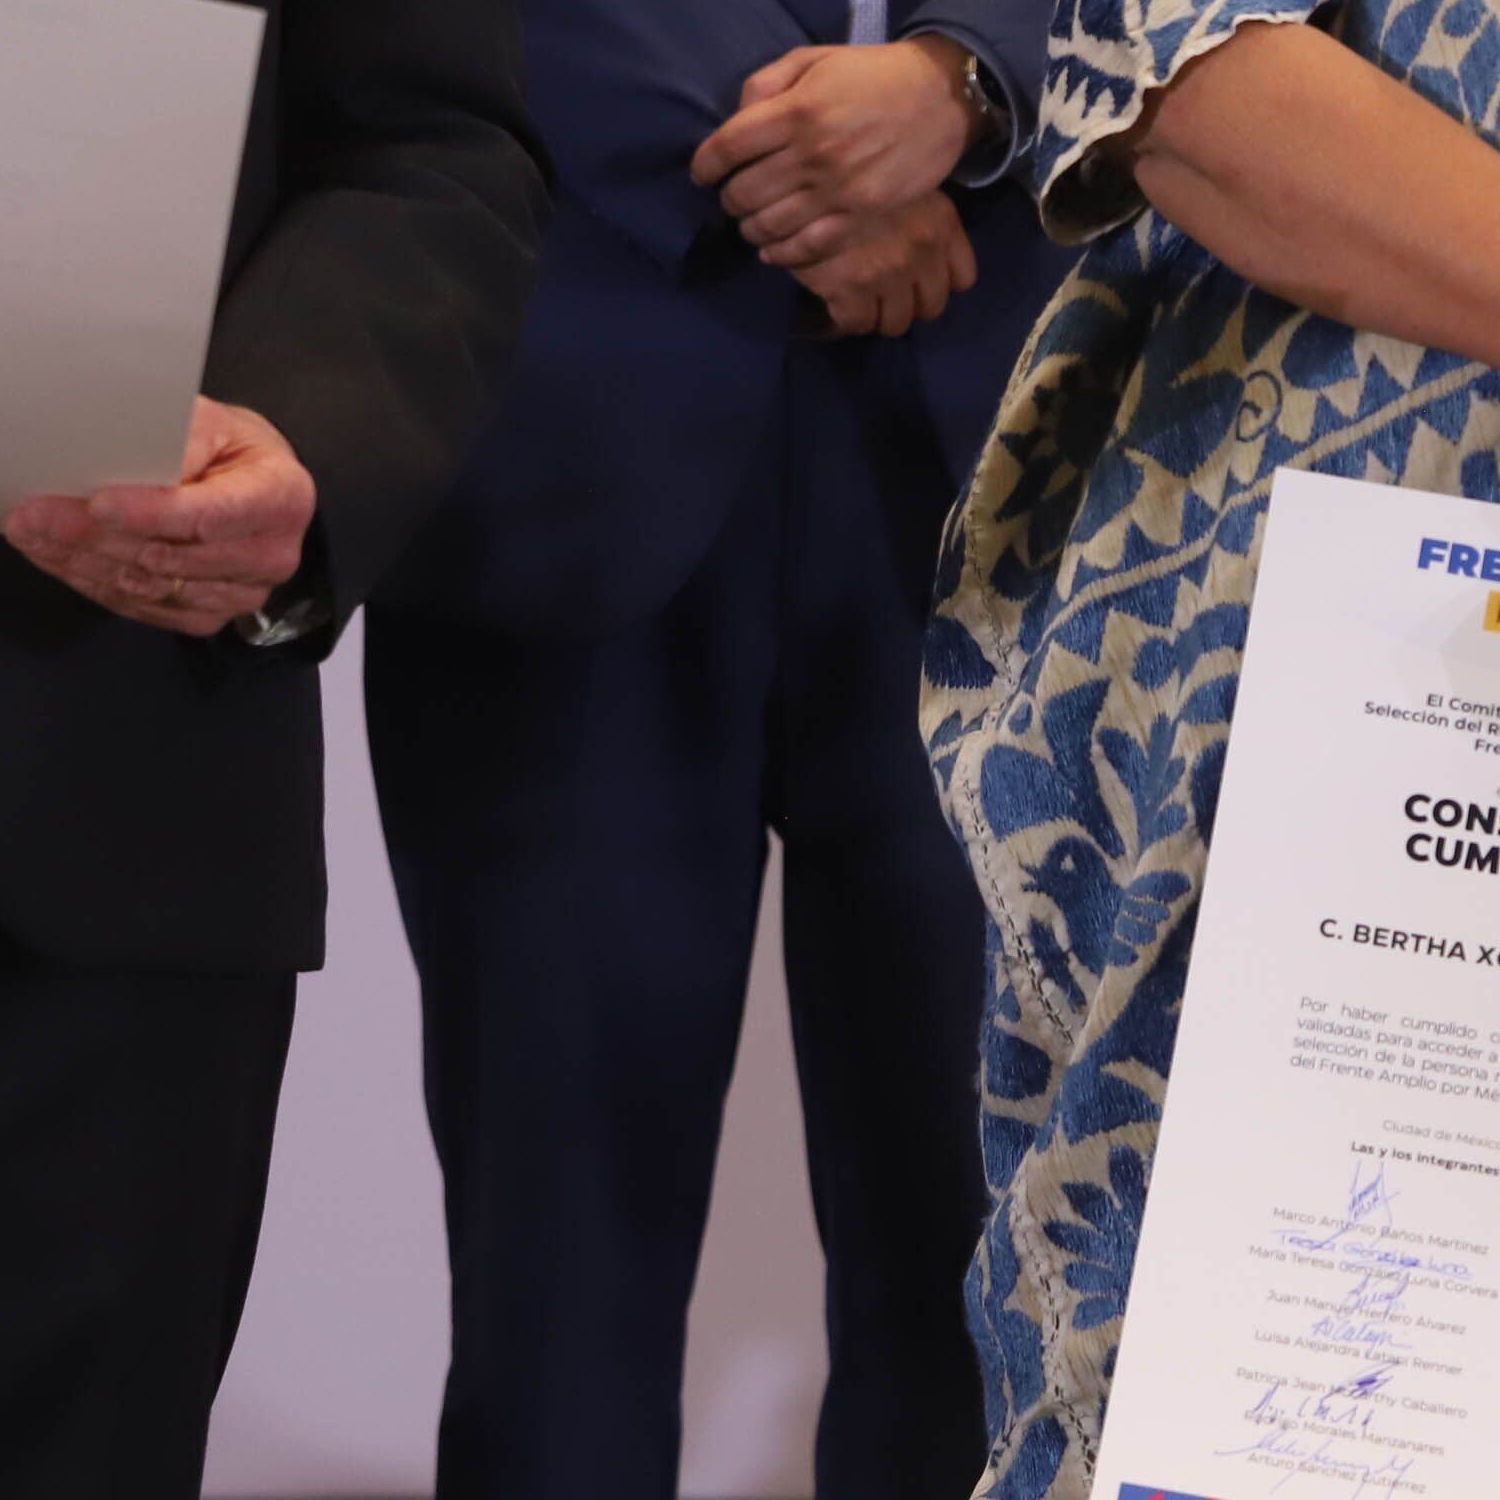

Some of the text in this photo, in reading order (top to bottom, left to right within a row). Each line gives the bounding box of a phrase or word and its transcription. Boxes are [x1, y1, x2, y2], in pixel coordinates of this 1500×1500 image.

[1363, 701, 1449, 728] Selección
[1454, 716, 1482, 734] del
[1426, 694, 1443, 709] El
[1318, 918, 1341, 941] C.
[1352, 924, 1468, 962] BERTHA
[1300, 997, 1328, 1014] Por
[1340, 1004, 1387, 1025] haber
[1400, 1017, 1477, 1040] cumplido
[1296, 1019, 1372, 1041] validadas
[1376, 1033, 1412, 1048] para
[1417, 1040, 1481, 1060] acceder
[1488, 1052, 1498, 1063] a
[1289, 1052, 1315, 1069] del
[1320, 1058, 1373, 1080] Frente
[1378, 1068, 1437, 1091] Amplio
[1440, 1082, 1469, 1097] por
[1293, 1036, 1368, 1059] selección
[1375, 1047, 1396, 1064] de
[1402, 1052, 1414, 1067] la
[1421, 1059, 1488, 1080] persona
[1382, 1119, 1431, 1139] Ciudad
[1434, 1128, 1452, 1142] de
[1350, 1140, 1374, 1155] Las
[1378, 1147, 1387, 1160] y
[1392, 1147, 1412, 1161] los
[1417, 1152, 1500, 1176] integrantes
[1272, 1207, 1318, 1225] Marco
[1291, 1252, 1334, 1270] Teresa
[1266, 1289, 1299, 1306] Juan
[1254, 1329, 1289, 1346] Luisa
[1236, 1367, 1286, 1386] Patricia
[1292, 1377, 1325, 1393] Jean
[1401, 1396, 1467, 1418] Caballero
[1303, 1421, 1356, 1440] Morales
